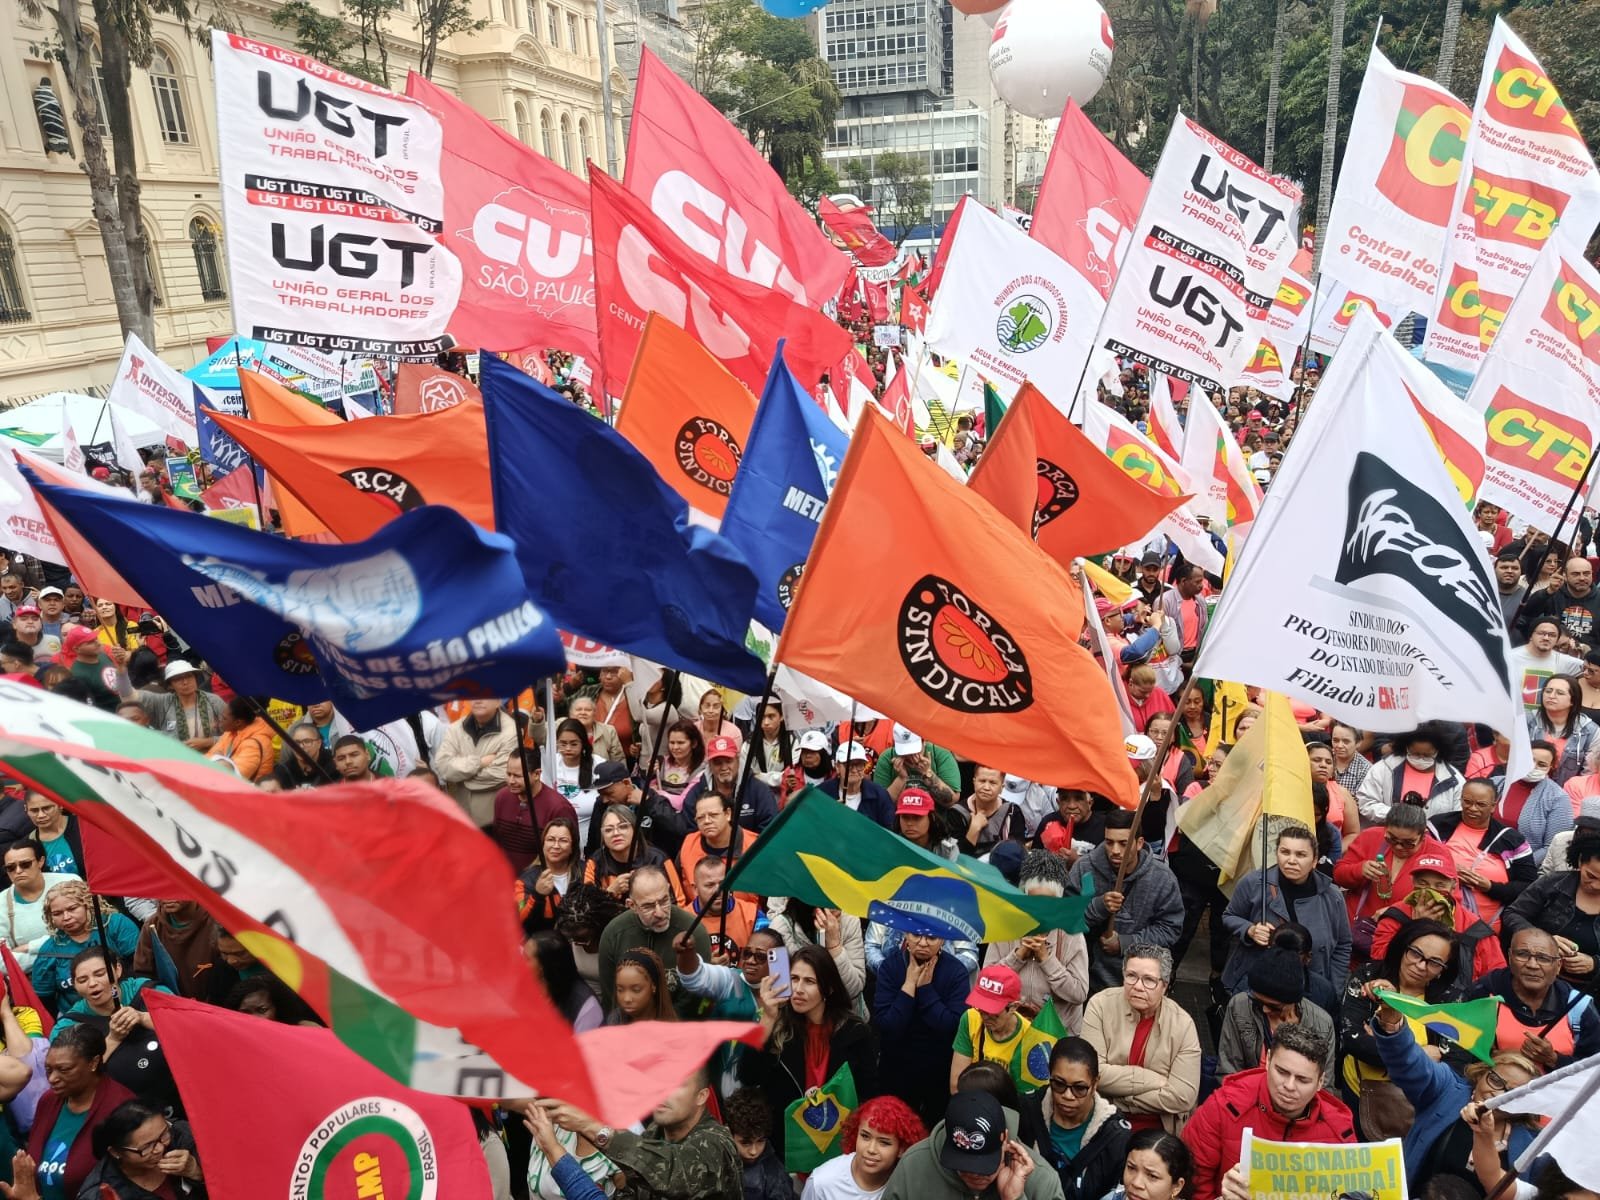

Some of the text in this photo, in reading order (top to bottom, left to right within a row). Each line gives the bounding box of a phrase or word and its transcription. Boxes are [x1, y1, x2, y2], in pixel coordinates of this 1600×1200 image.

[239, 41, 269, 57] UGT
[272, 49, 302, 66] UGT
[305, 60, 334, 78] UGT
[257, 70, 410, 159] UGT
[264, 128, 316, 143] UNIÃO
[1508, 134, 1526, 146] dos
[1230, 151, 1250, 170] UGT
[1480, 131, 1588, 177] Trabalhadoras do Brasil
[268, 144, 416, 194] TRABALHADORES
[257, 178, 287, 193] UGT
[291, 184, 319, 197] UGT
[323, 188, 352, 202] UGT
[1191, 153, 1285, 246] UGT
[258, 193, 387, 221] UGT UGT UGT UGT
[1457, 223, 1474, 232] Cen
[1462, 232, 1476, 241] Tra
[271, 222, 434, 289] UGT
[1340, 243, 1351, 255] e
[1348, 225, 1412, 263] Central
[1151, 240, 1173, 254] UGT
[1199, 262, 1222, 276] UGT
[1220, 273, 1240, 290] UGT
[1158, 230, 1267, 306] UGT UGT UGT UGT UGT
[1480, 248, 1532, 271] Trabalhado
[1510, 268, 1527, 278] Bra
[272, 280, 434, 306] UNIÃO GERAL DOS
[478, 265, 529, 297] SÃO
[994, 278, 1021, 307] MOVIMENTO
[1021, 275, 1032, 285] DOS
[1034, 276, 1061, 299] ATINGIDOS
[278, 294, 428, 319] TRABALHADORES
[1137, 306, 1172, 327] UNIÃO
[1150, 265, 1243, 348] UGT
[264, 330, 443, 354] UGT UGT UGT UGT UGT UGT
[1430, 332, 1478, 351] Central dos
[1530, 328, 1566, 350] Central
[991, 364, 1024, 384] MERCADORIA
[998, 360, 1028, 379] ENERGIA
[1111, 343, 1220, 393] UGT UGT UGT UGT UGT
[1487, 407, 1592, 481] CTB
[351, 471, 408, 502] RÇA
[1496, 469, 1516, 481] dos
[1486, 474, 1531, 501] alhadoras
[1532, 499, 1544, 509] do
[779, 584, 792, 608] SIN
[408, 638, 468, 672] SÃO
[467, 600, 544, 659] PAULO
[1349, 610, 1410, 635] SINDICATO DOS
[905, 605, 1021, 707] SINDICAL
[1282, 613, 1369, 652] PROFESSORES
[1400, 643, 1453, 690] OFICIAL
[1308, 647, 1340, 670] DO
[1340, 655, 1376, 675] ESTADO
[1284, 667, 1364, 706] Filiado
[1366, 686, 1375, 708] à
[979, 976, 1004, 994] CUT
[309, 1101, 381, 1151] POPULARES
[417, 1129, 435, 1181] BRASIL
[1251, 1147, 1372, 1171] BOLSONARO
[1272, 1173, 1298, 1192] NA
